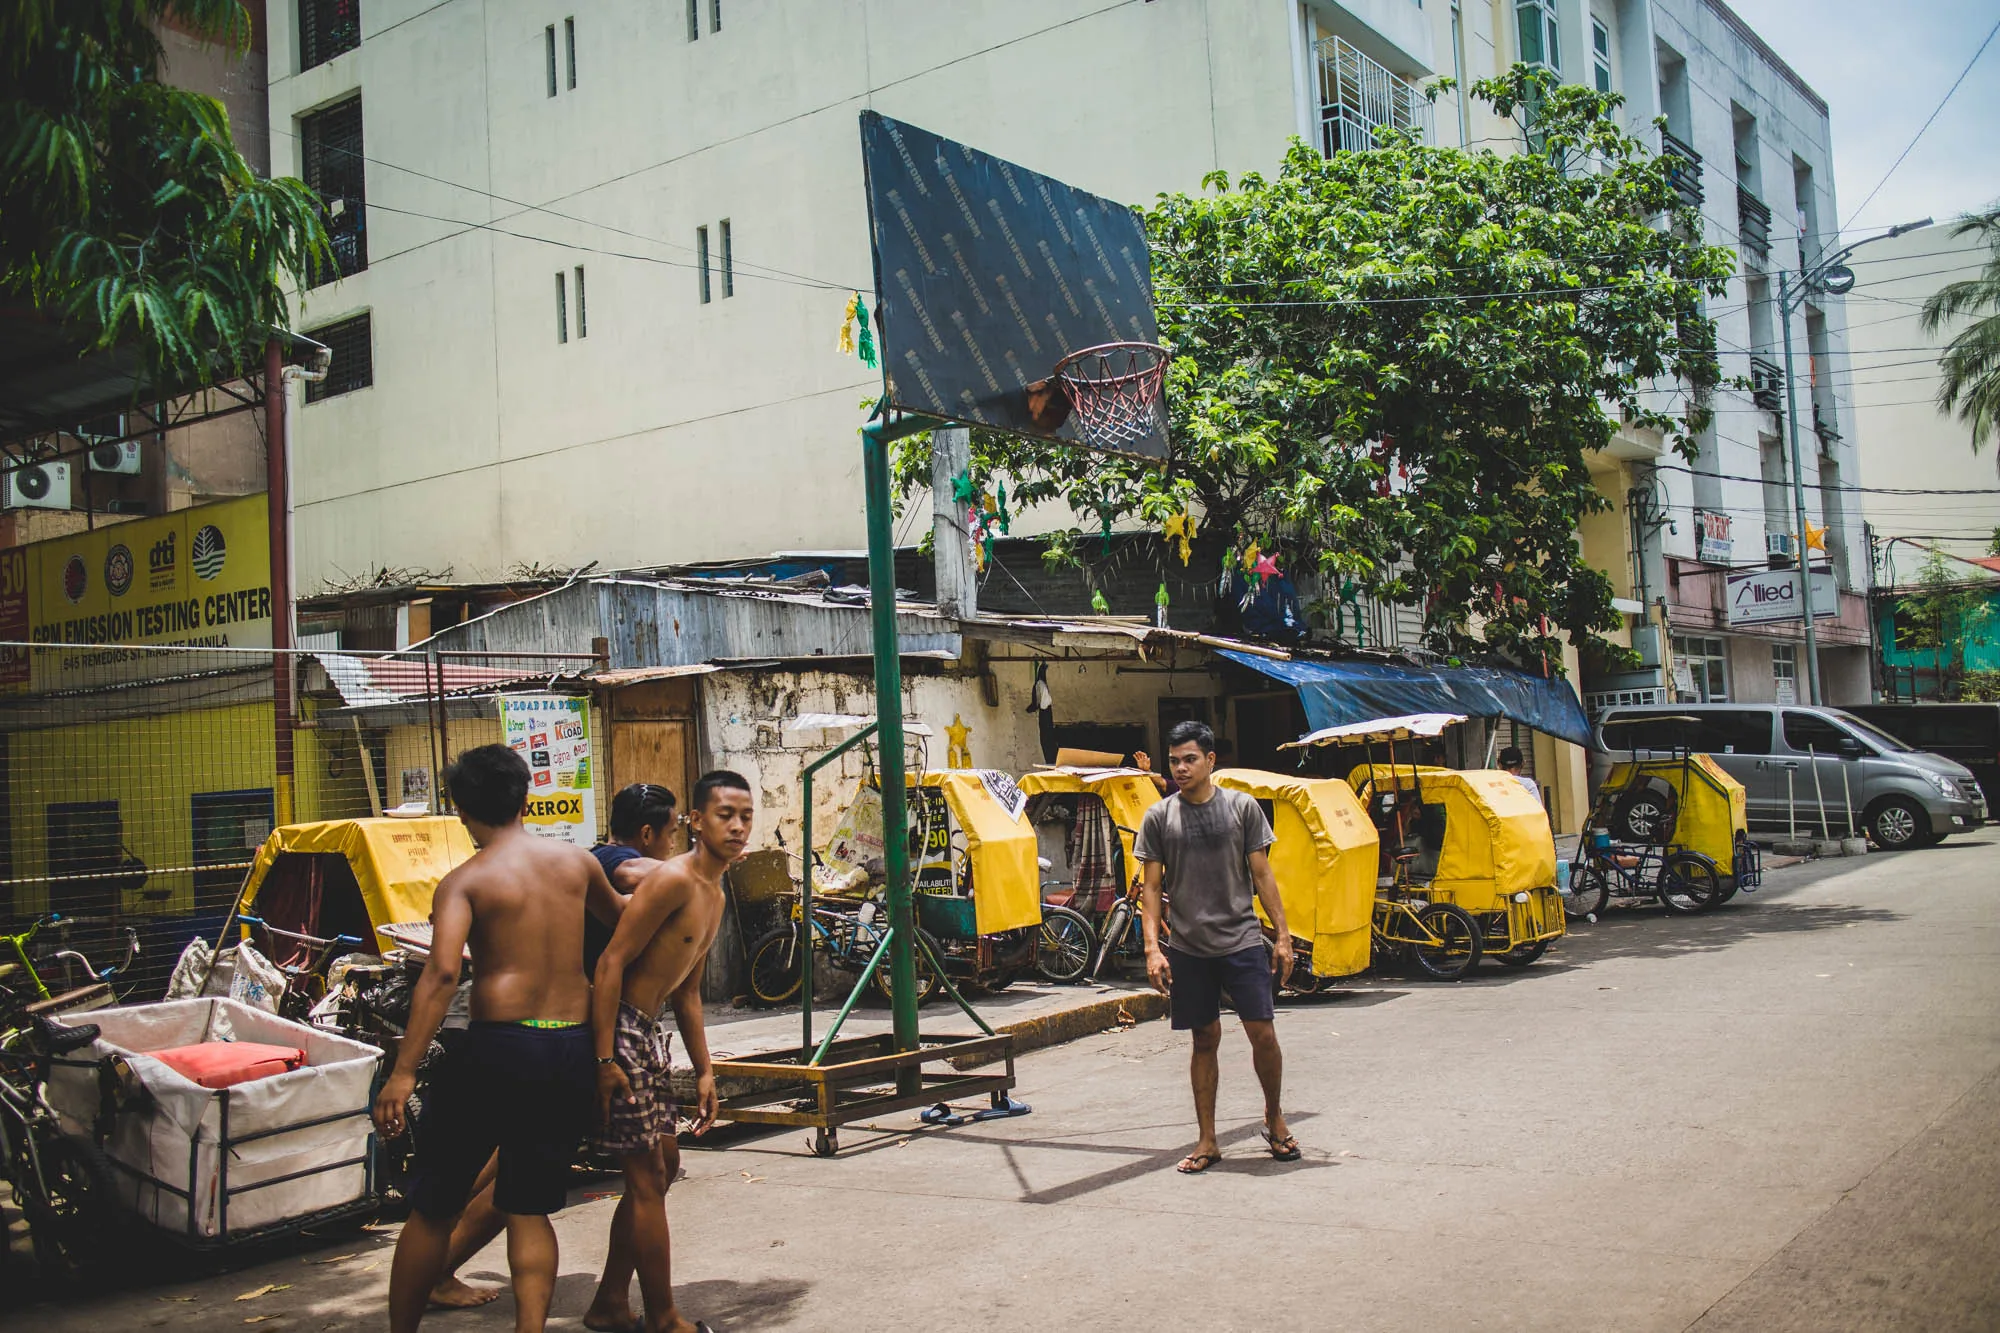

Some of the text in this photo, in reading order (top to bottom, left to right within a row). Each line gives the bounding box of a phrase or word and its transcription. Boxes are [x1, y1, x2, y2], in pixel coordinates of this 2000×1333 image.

[889, 128, 928, 195] MULTIFORM
[945, 174, 981, 238] MULTIFORM
[1038, 184, 1071, 244] MULTIFORM
[898, 207, 935, 274] MULTIFORM
[998, 216, 1032, 279] MULTIFORM
[1085, 224, 1117, 282] MULTIFORM
[953, 251, 989, 315] MULTIFORM
[1048, 257, 1080, 316] MULTIFORM
[907, 287, 944, 352] MULTIFORM
[962, 328, 999, 391] MULTIFORM
[65, 610, 133, 648] EMISSION
[136, 598, 200, 637] TESTING
[205, 587, 271, 626] CENTER
[82, 648, 128, 669] REMEDIOS
[188, 633, 229, 652] MANILA
[564, 727, 582, 739] LOAD
[527, 799, 580, 817] XEROX
